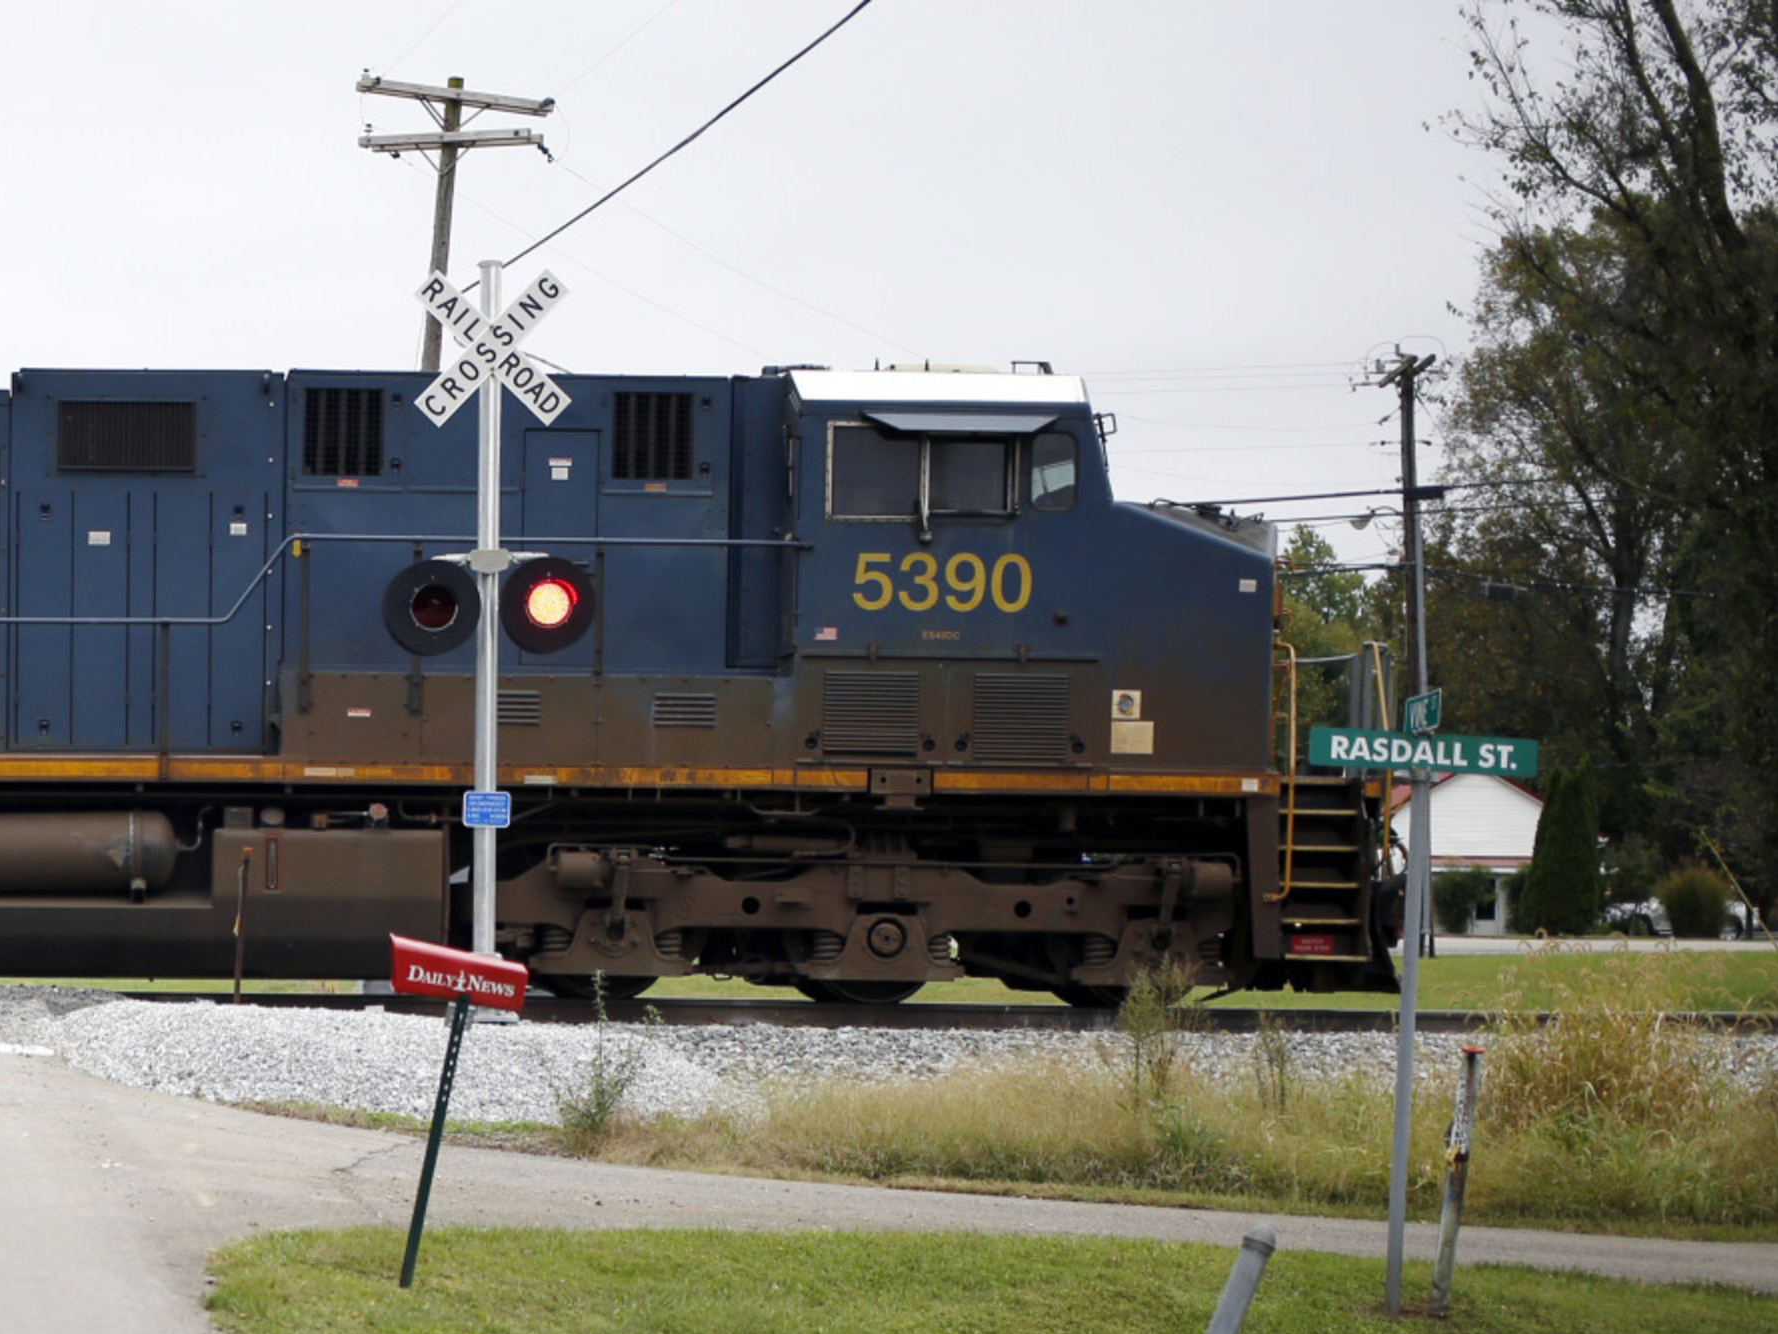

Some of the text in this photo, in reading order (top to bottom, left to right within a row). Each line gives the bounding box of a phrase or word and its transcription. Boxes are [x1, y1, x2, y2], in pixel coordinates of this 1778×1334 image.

[425, 277, 560, 417] CROSSING
[852, 551, 1033, 613] 5390
[1330, 734, 1518, 770] RASDALL ST.
[406, 964, 515, 997] DAILY NEWS
